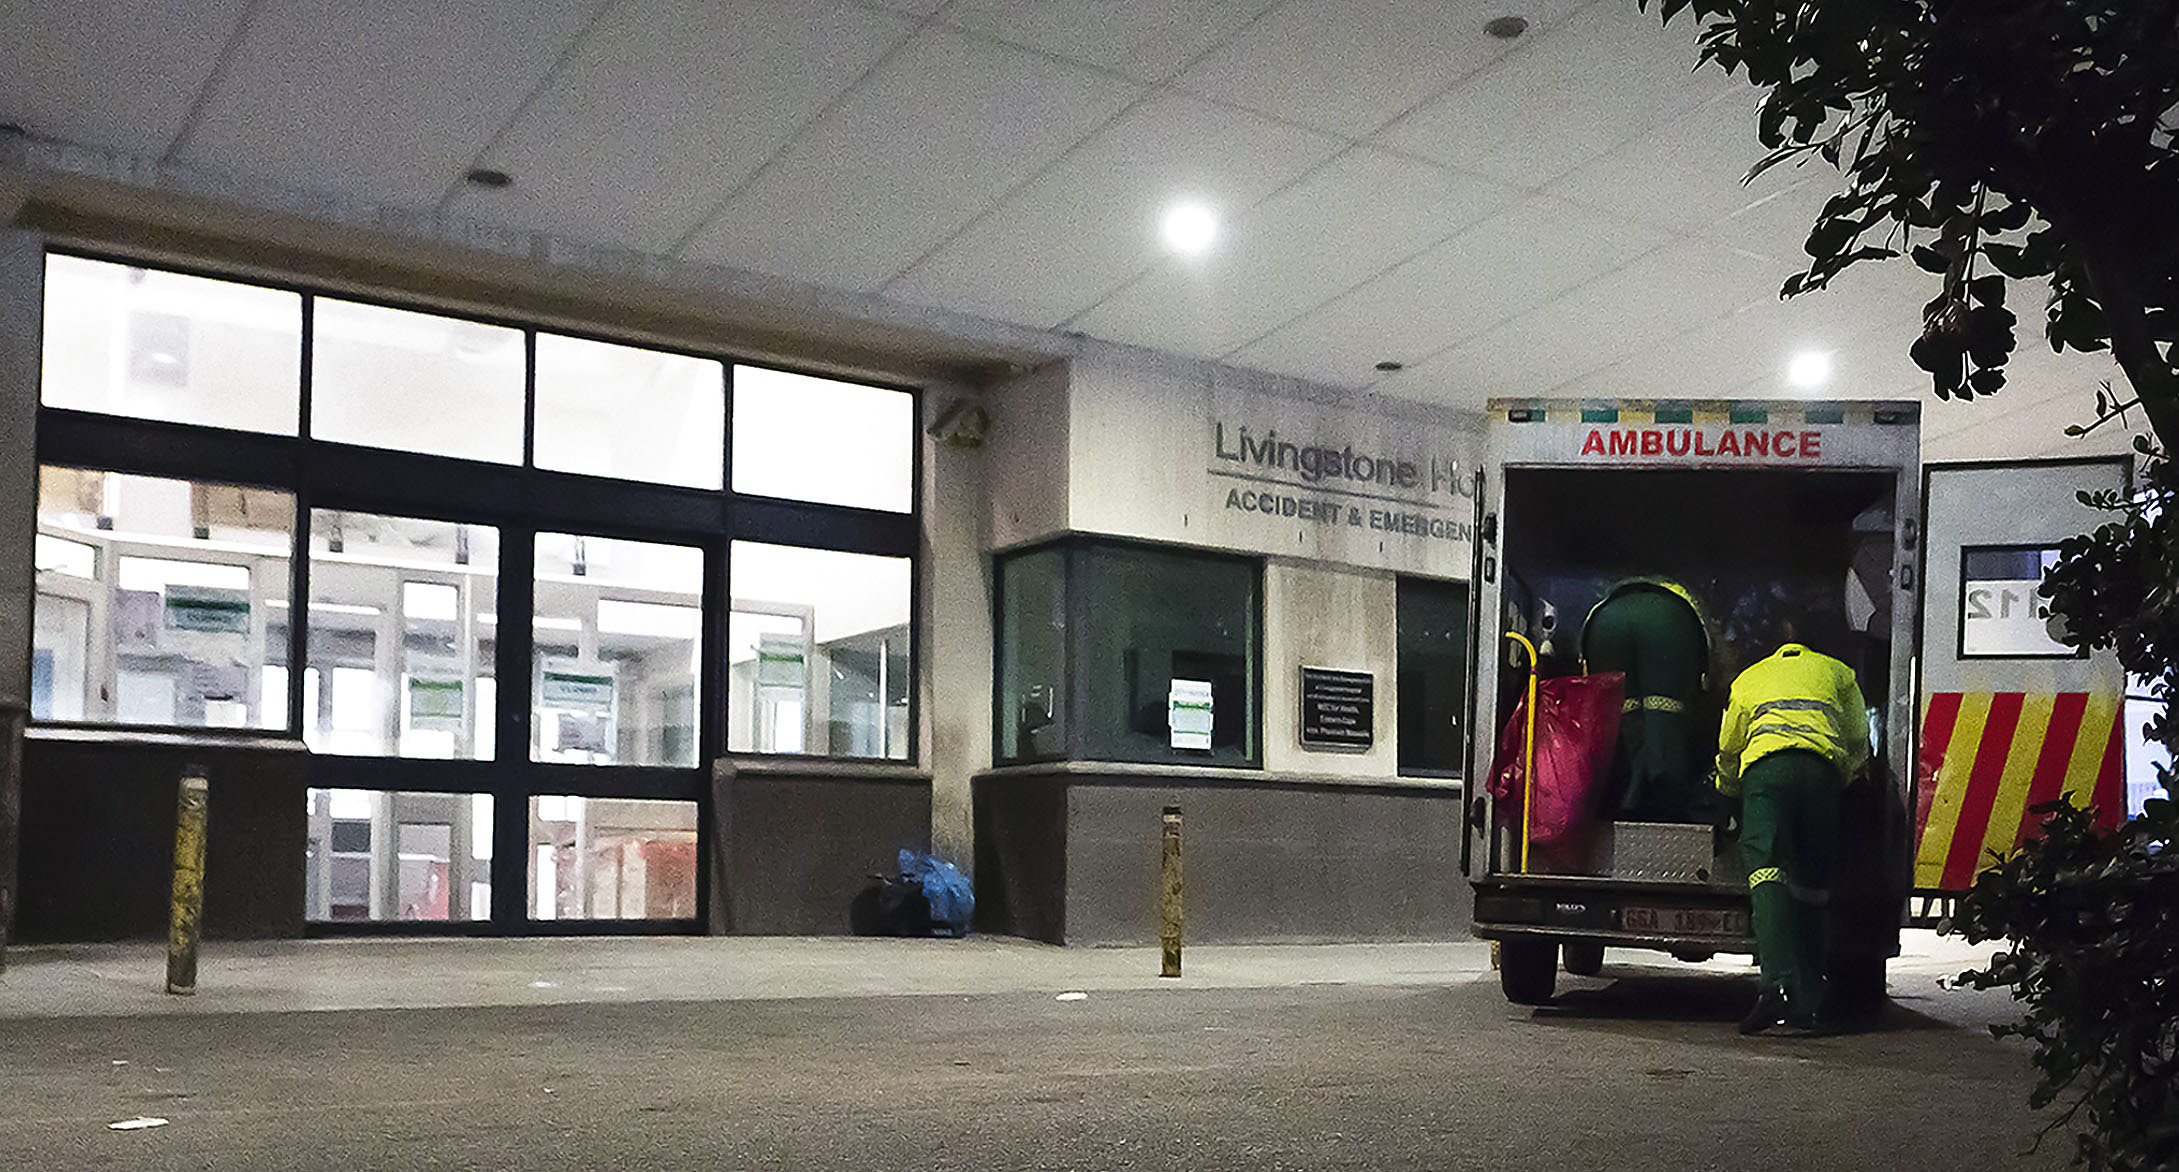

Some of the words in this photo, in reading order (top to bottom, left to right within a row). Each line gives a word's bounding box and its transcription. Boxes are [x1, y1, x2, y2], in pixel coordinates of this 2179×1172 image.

[1215, 421, 1416, 489] Livingstone
[1581, 429, 1822, 458] AMBULANCE
[1226, 488, 1341, 525] ACCIDENT
[1348, 507, 1362, 527] &
[1369, 509, 1472, 542] EMERGEN
